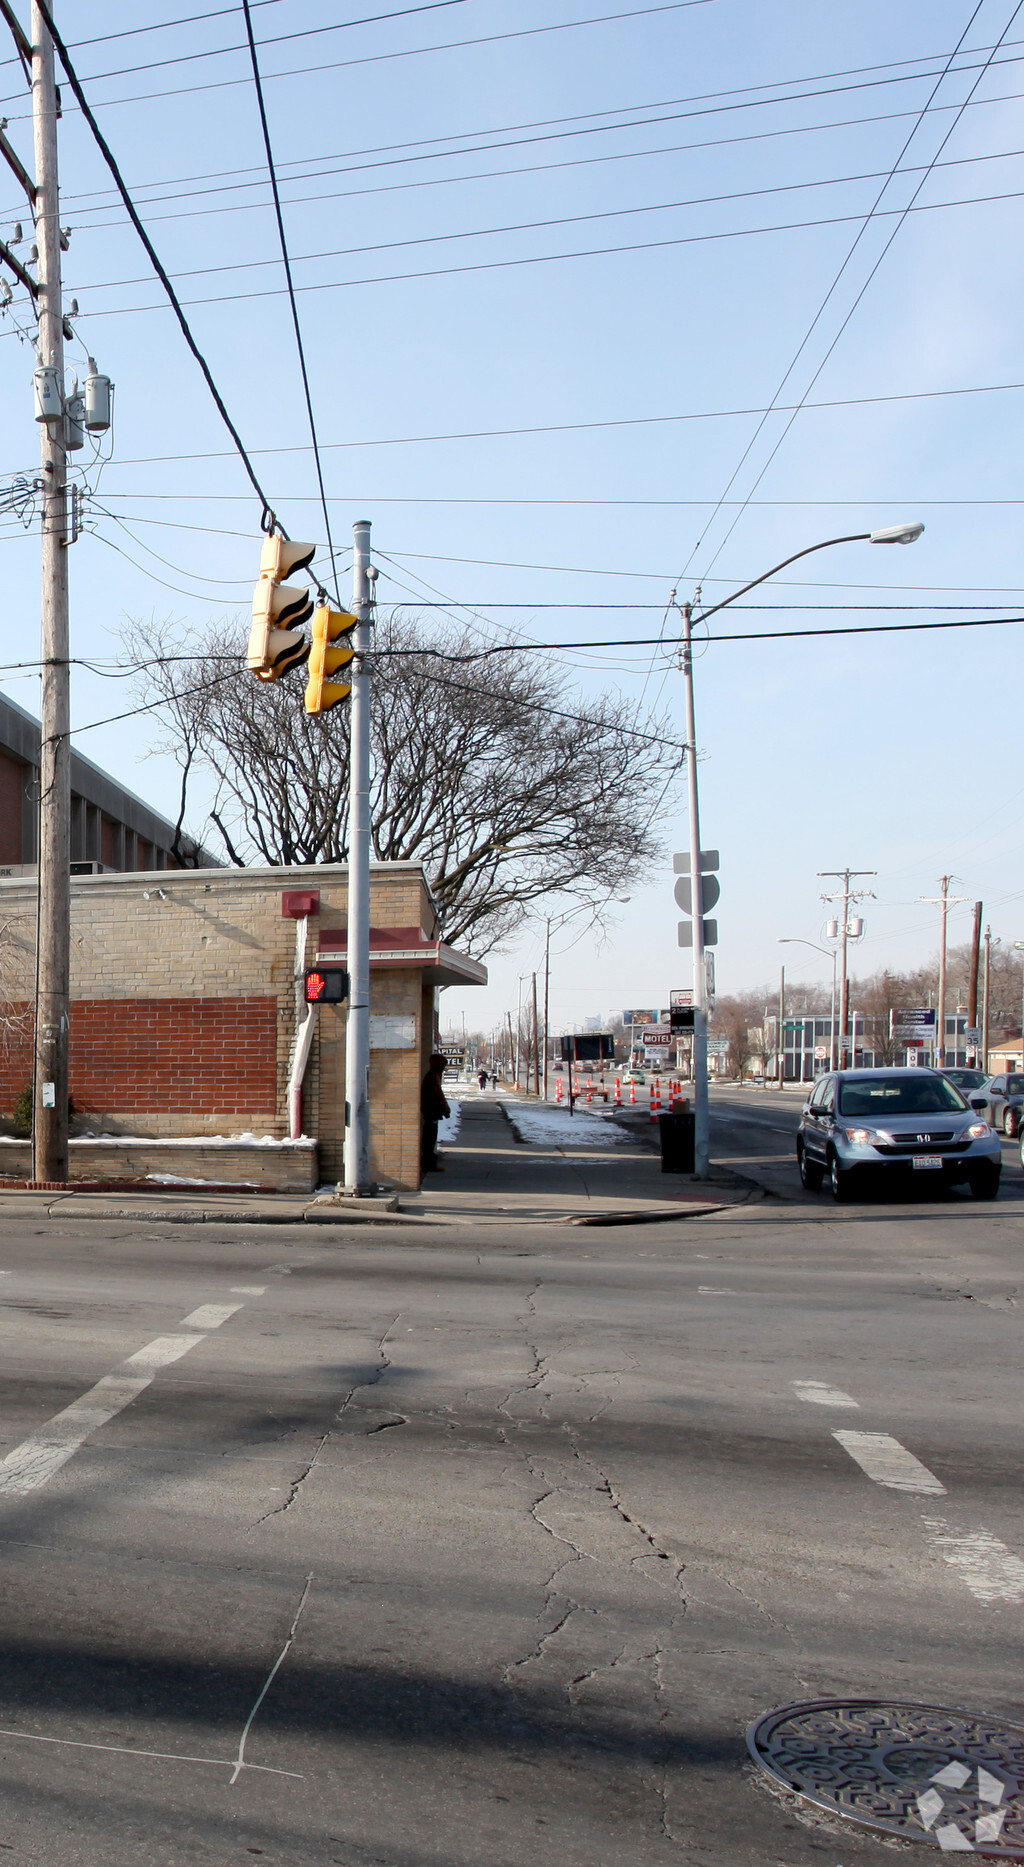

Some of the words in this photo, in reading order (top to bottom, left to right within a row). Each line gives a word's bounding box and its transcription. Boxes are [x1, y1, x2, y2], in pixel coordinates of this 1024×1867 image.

[644, 1034, 671, 1043] MOTEL
[967, 1037, 979, 1045] 35
[446, 1058, 462, 1066] TEL
